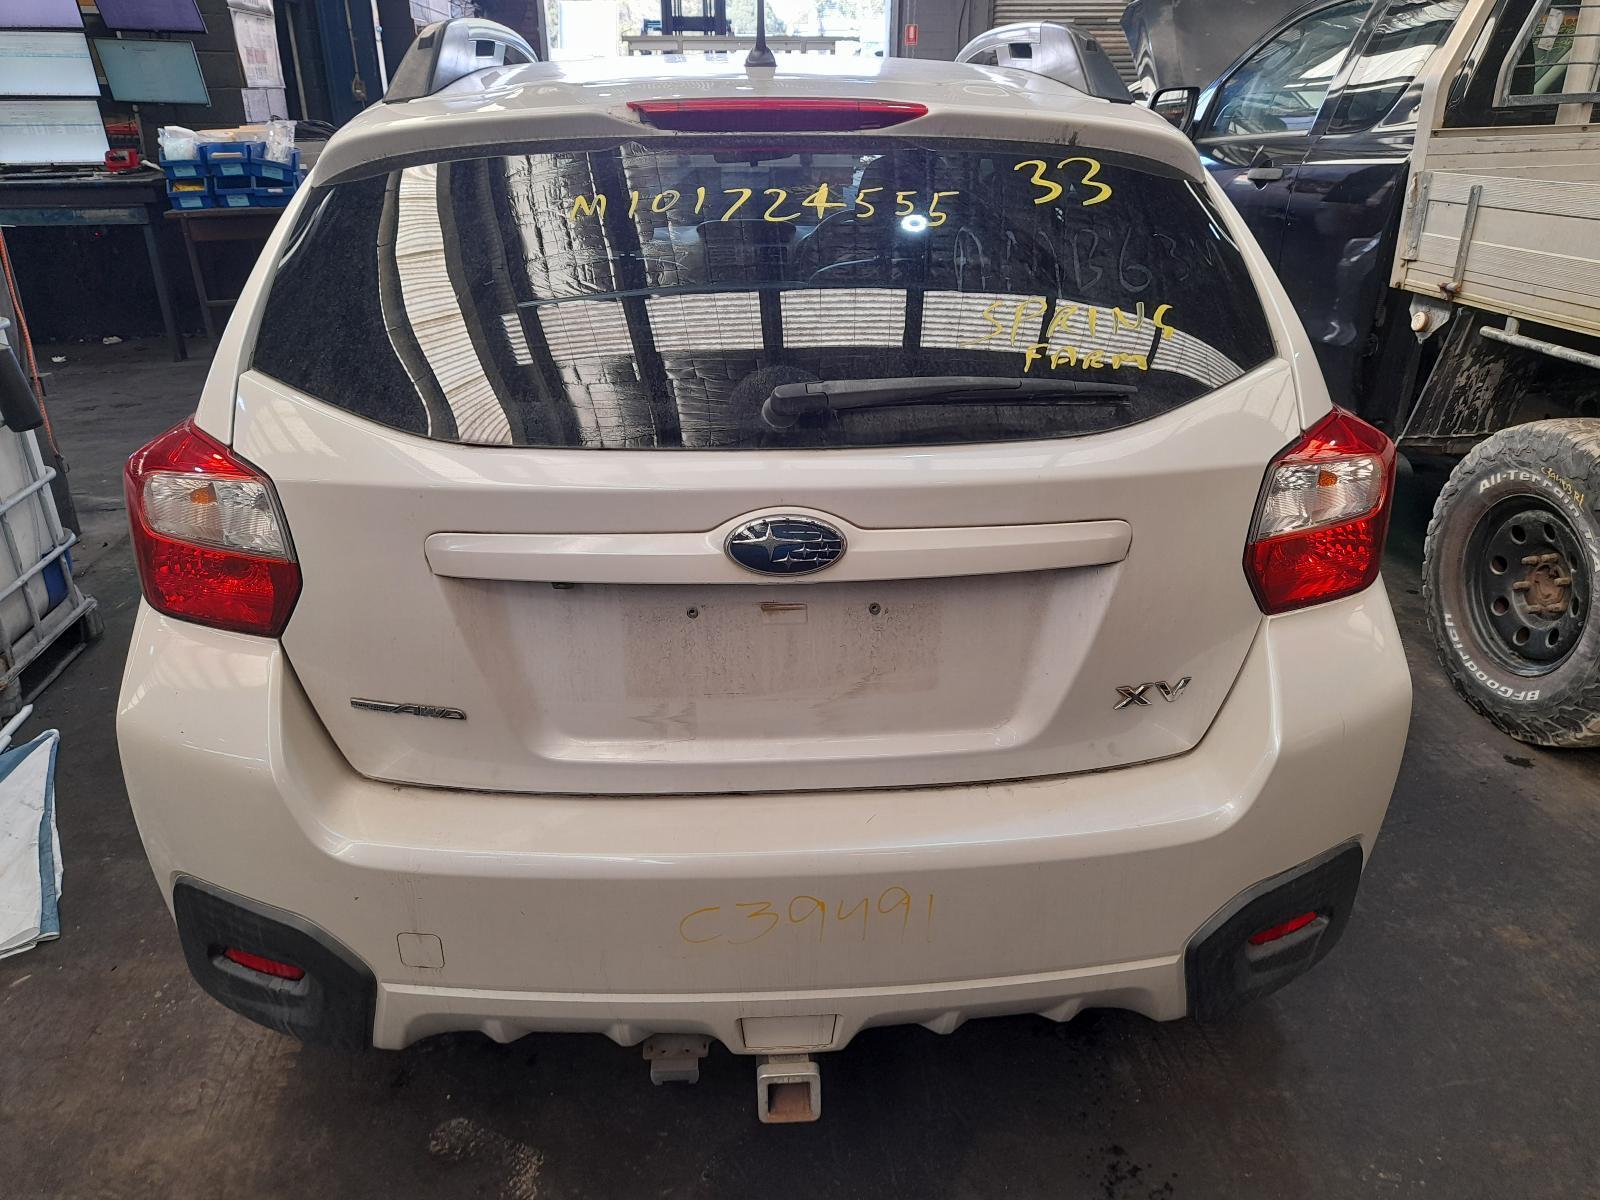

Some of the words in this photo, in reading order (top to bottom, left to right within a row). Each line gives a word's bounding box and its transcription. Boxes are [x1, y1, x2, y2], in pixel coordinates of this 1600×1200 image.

[570, 182, 960, 227] M101724555
[1013, 157, 1112, 206] 33
[1023, 343, 1149, 373] FARM
[1479, 469, 1581, 519] All-Terrain
[1444, 613, 1540, 701] BFGoodrich
[1112, 676, 1193, 710] XV
[679, 886, 934, 945] C39491
